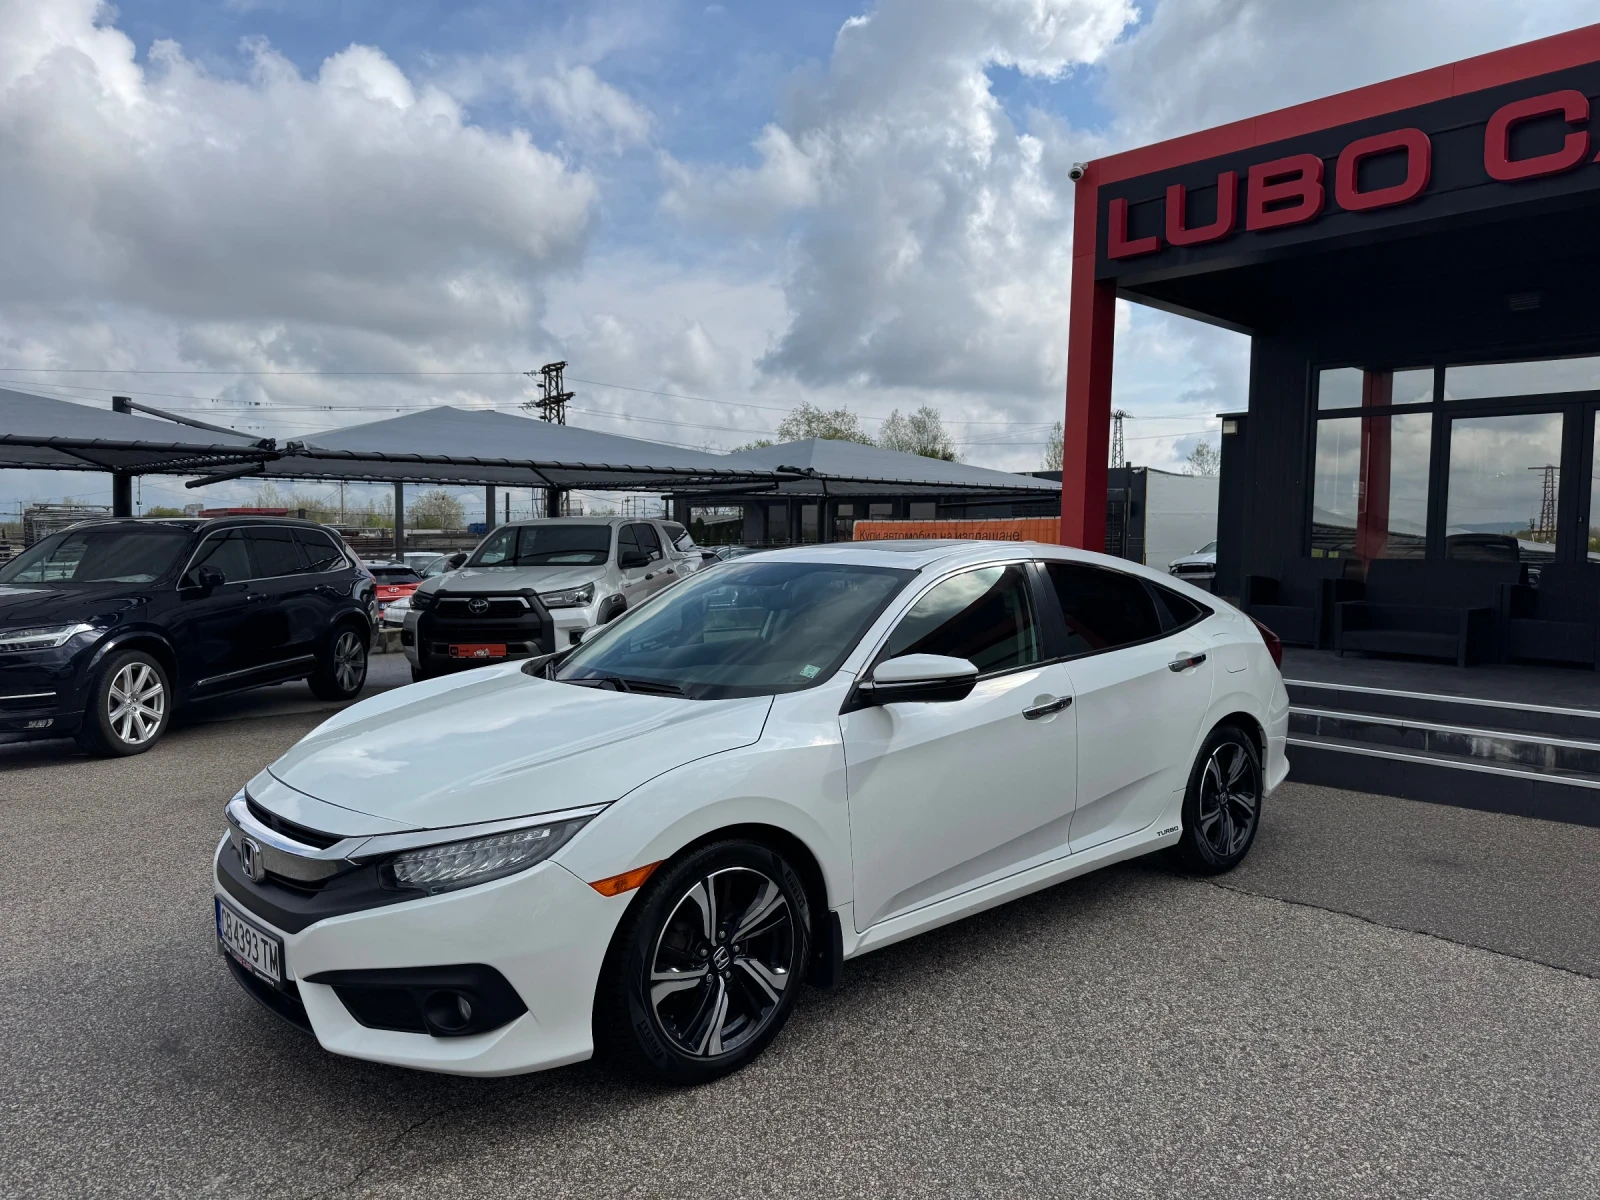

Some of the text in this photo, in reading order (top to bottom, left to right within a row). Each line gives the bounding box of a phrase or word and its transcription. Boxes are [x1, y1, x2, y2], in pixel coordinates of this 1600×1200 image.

[1108, 89, 1600, 259] LUBO C
[940, 531, 952, 540] на
[1156, 826, 1179, 836] TURBO
[637, 1019, 665, 1060] PIRELLI
